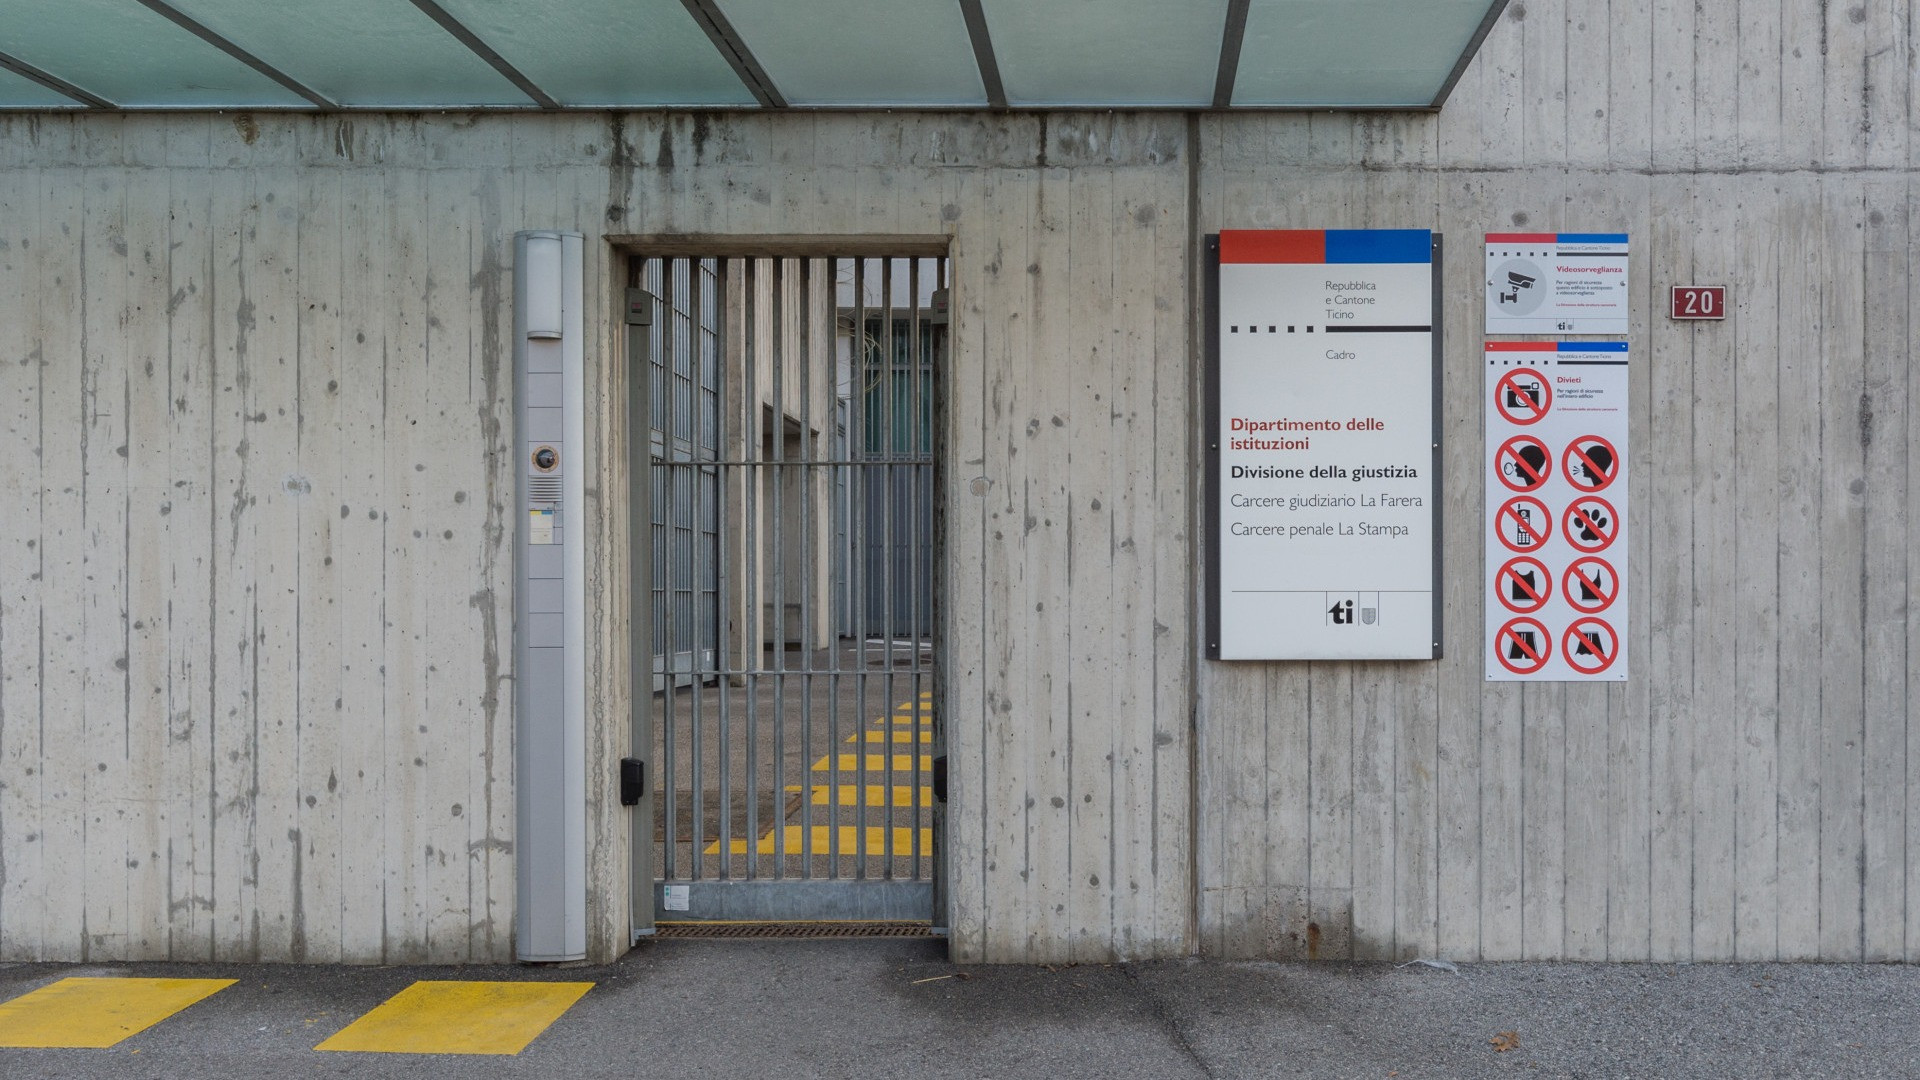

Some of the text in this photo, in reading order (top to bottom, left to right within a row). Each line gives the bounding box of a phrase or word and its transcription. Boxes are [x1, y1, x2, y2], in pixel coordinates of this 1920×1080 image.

[1556, 266, 1622, 274] Videosorveglianza
[1325, 280, 1376, 292] Repubblica
[1325, 295, 1375, 305] e Cantone
[1684, 290, 1713, 314] 20
[1326, 309, 1354, 319] Ticino
[1558, 322, 1565, 330] ti
[1326, 349, 1356, 360] Cadro
[1230, 418, 1384, 434] Dipartimento delle
[1230, 437, 1309, 450] istituzioni
[1231, 465, 1418, 482] Divisione della giustizia
[1230, 494, 1423, 511] Carcere giudiziario La Farera
[1230, 522, 1409, 539] Carcere penale La Stampa
[1328, 599, 1353, 624] ti
